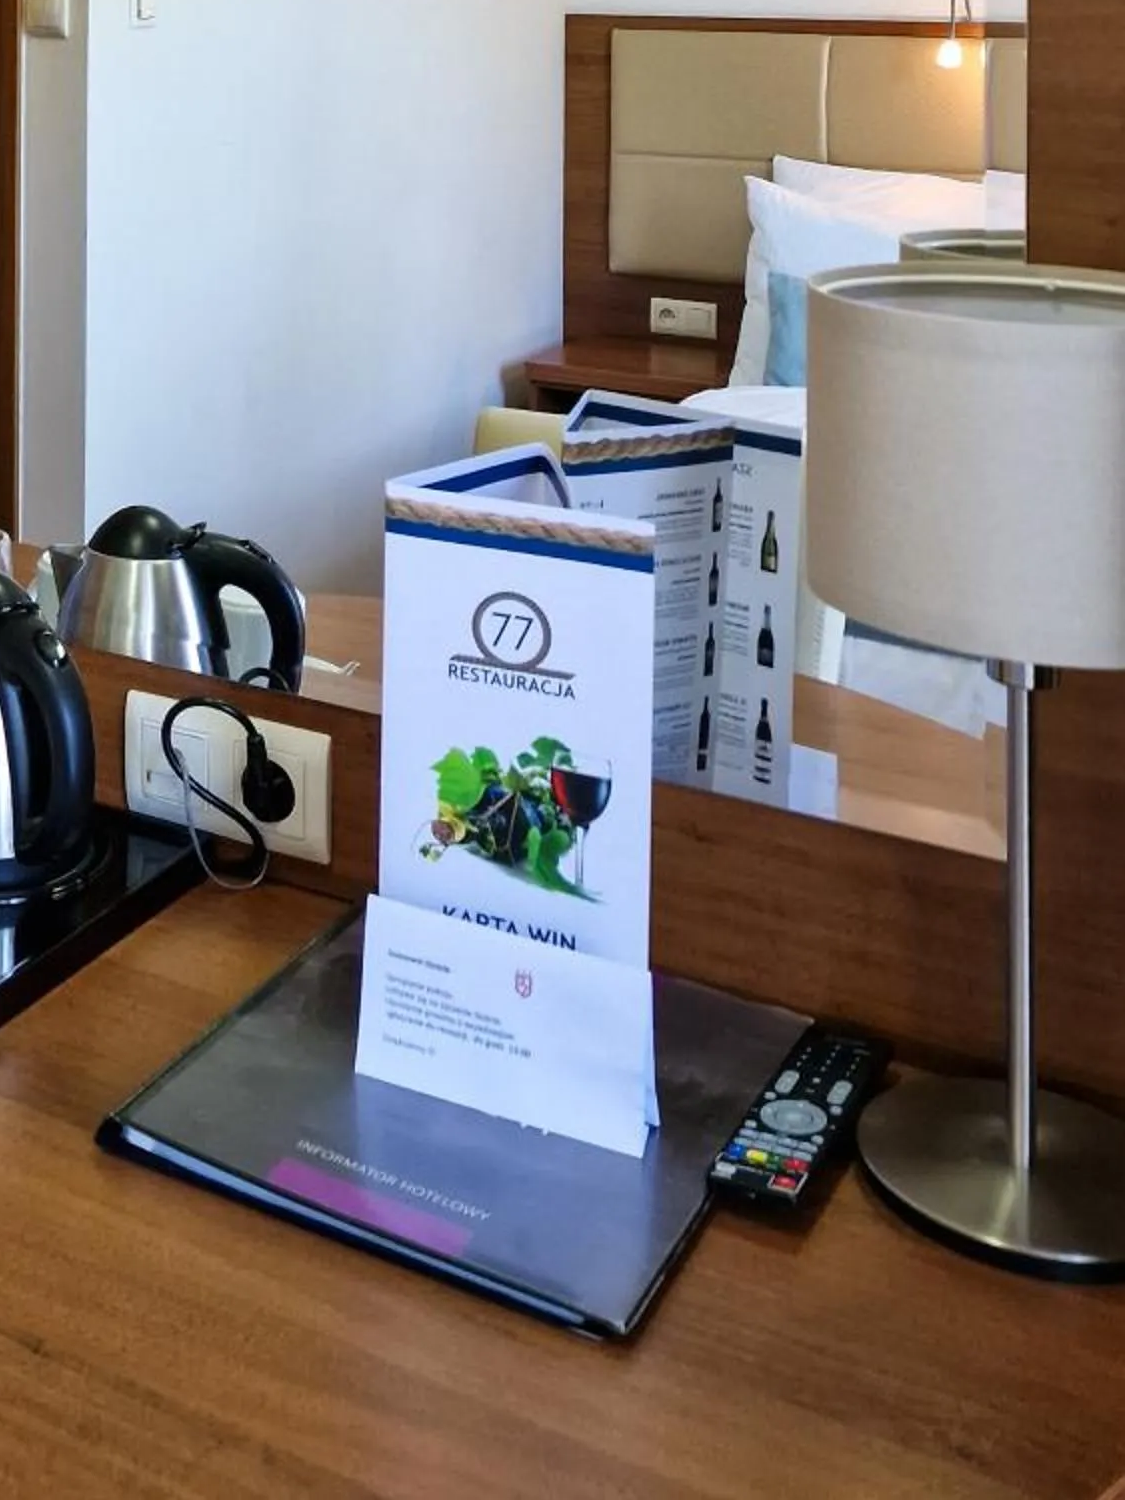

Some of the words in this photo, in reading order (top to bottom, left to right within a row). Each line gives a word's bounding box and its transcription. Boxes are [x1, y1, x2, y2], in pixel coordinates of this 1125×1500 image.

[492, 611, 534, 650] 77
[448, 663, 576, 700] RESTAURACJA
[528, 924, 576, 951] WIN
[296, 1138, 396, 1186] INFORMATOR
[399, 1177, 491, 1222] HOTELOWY
